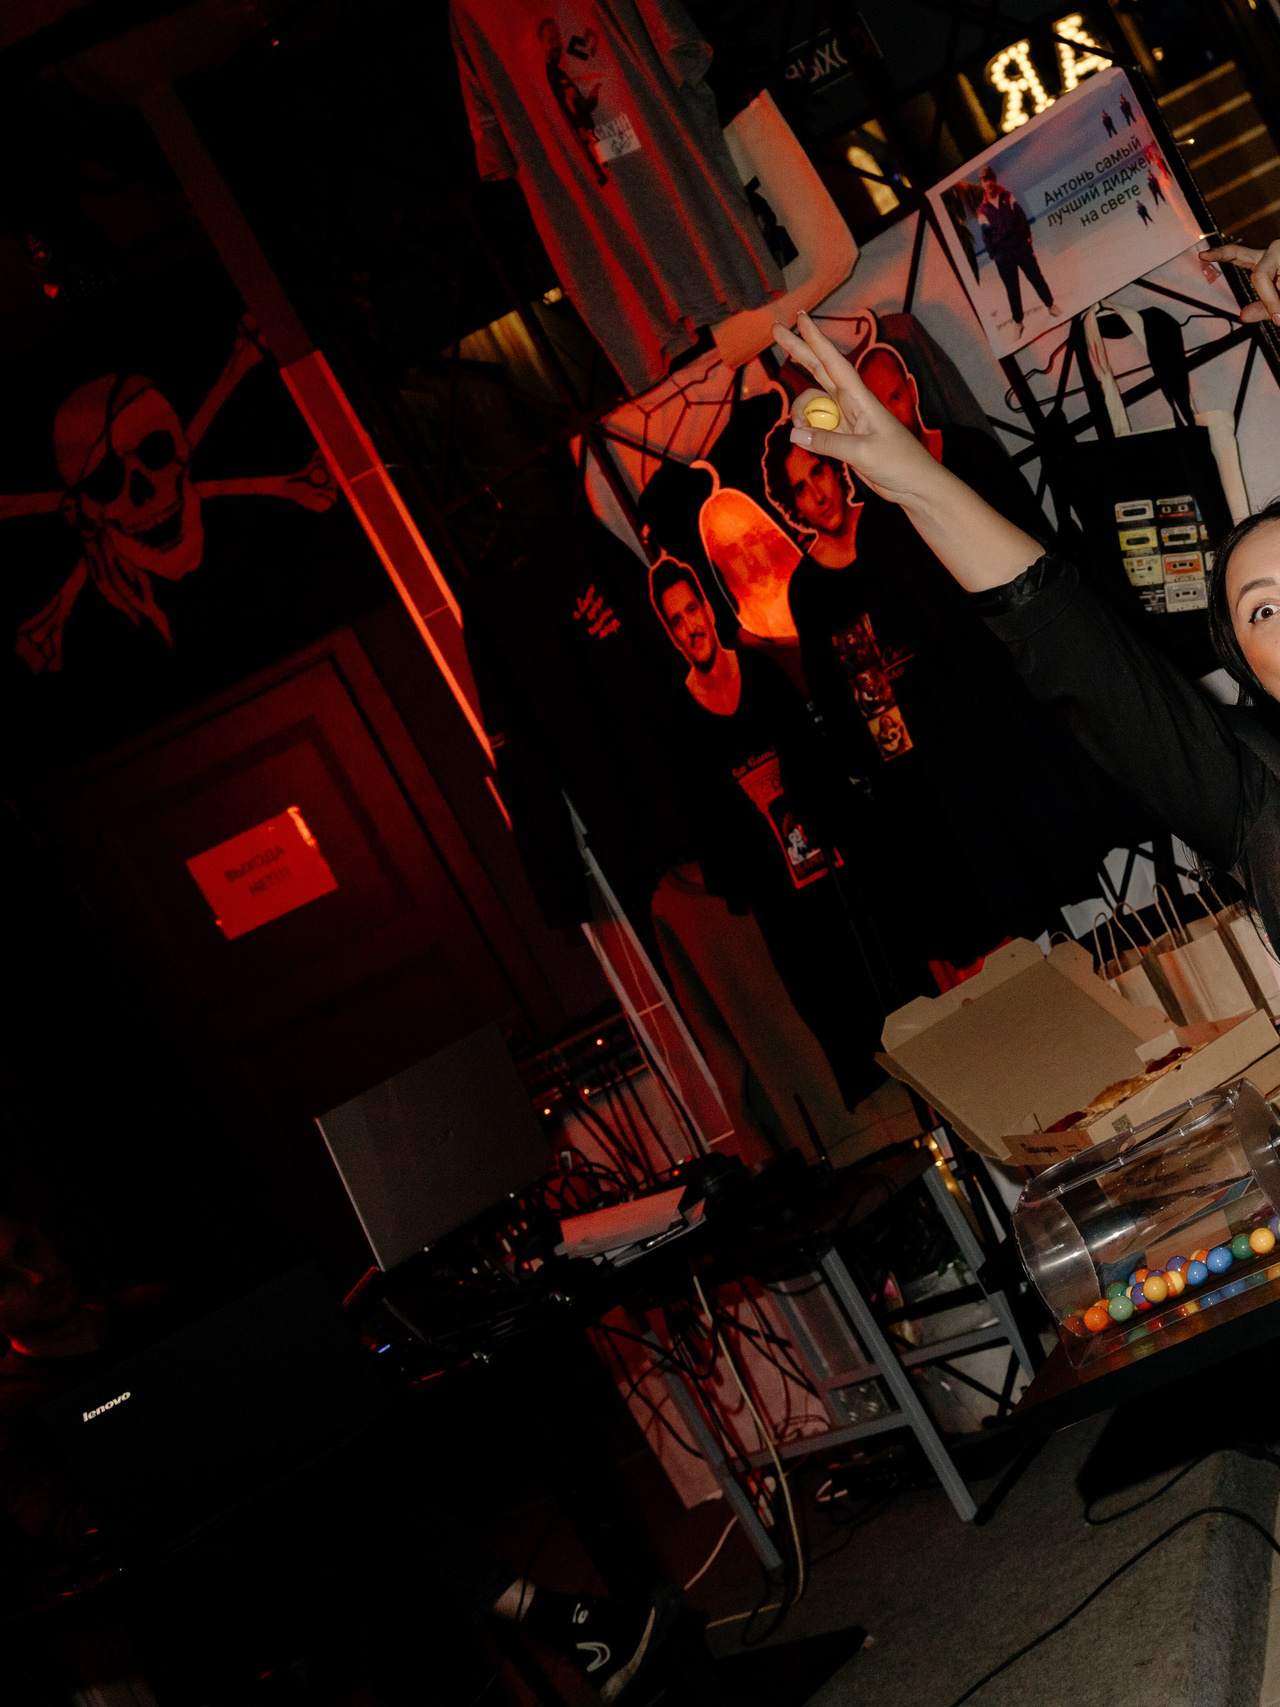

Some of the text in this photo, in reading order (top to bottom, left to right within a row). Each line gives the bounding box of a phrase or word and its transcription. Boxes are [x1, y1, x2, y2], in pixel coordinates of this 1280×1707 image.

[1044, 135, 1142, 206] Антонь самый
[1047, 184, 1101, 228] лучший
[1081, 184, 1141, 227] на свете
[82, 1391, 131, 1423] lenovo
